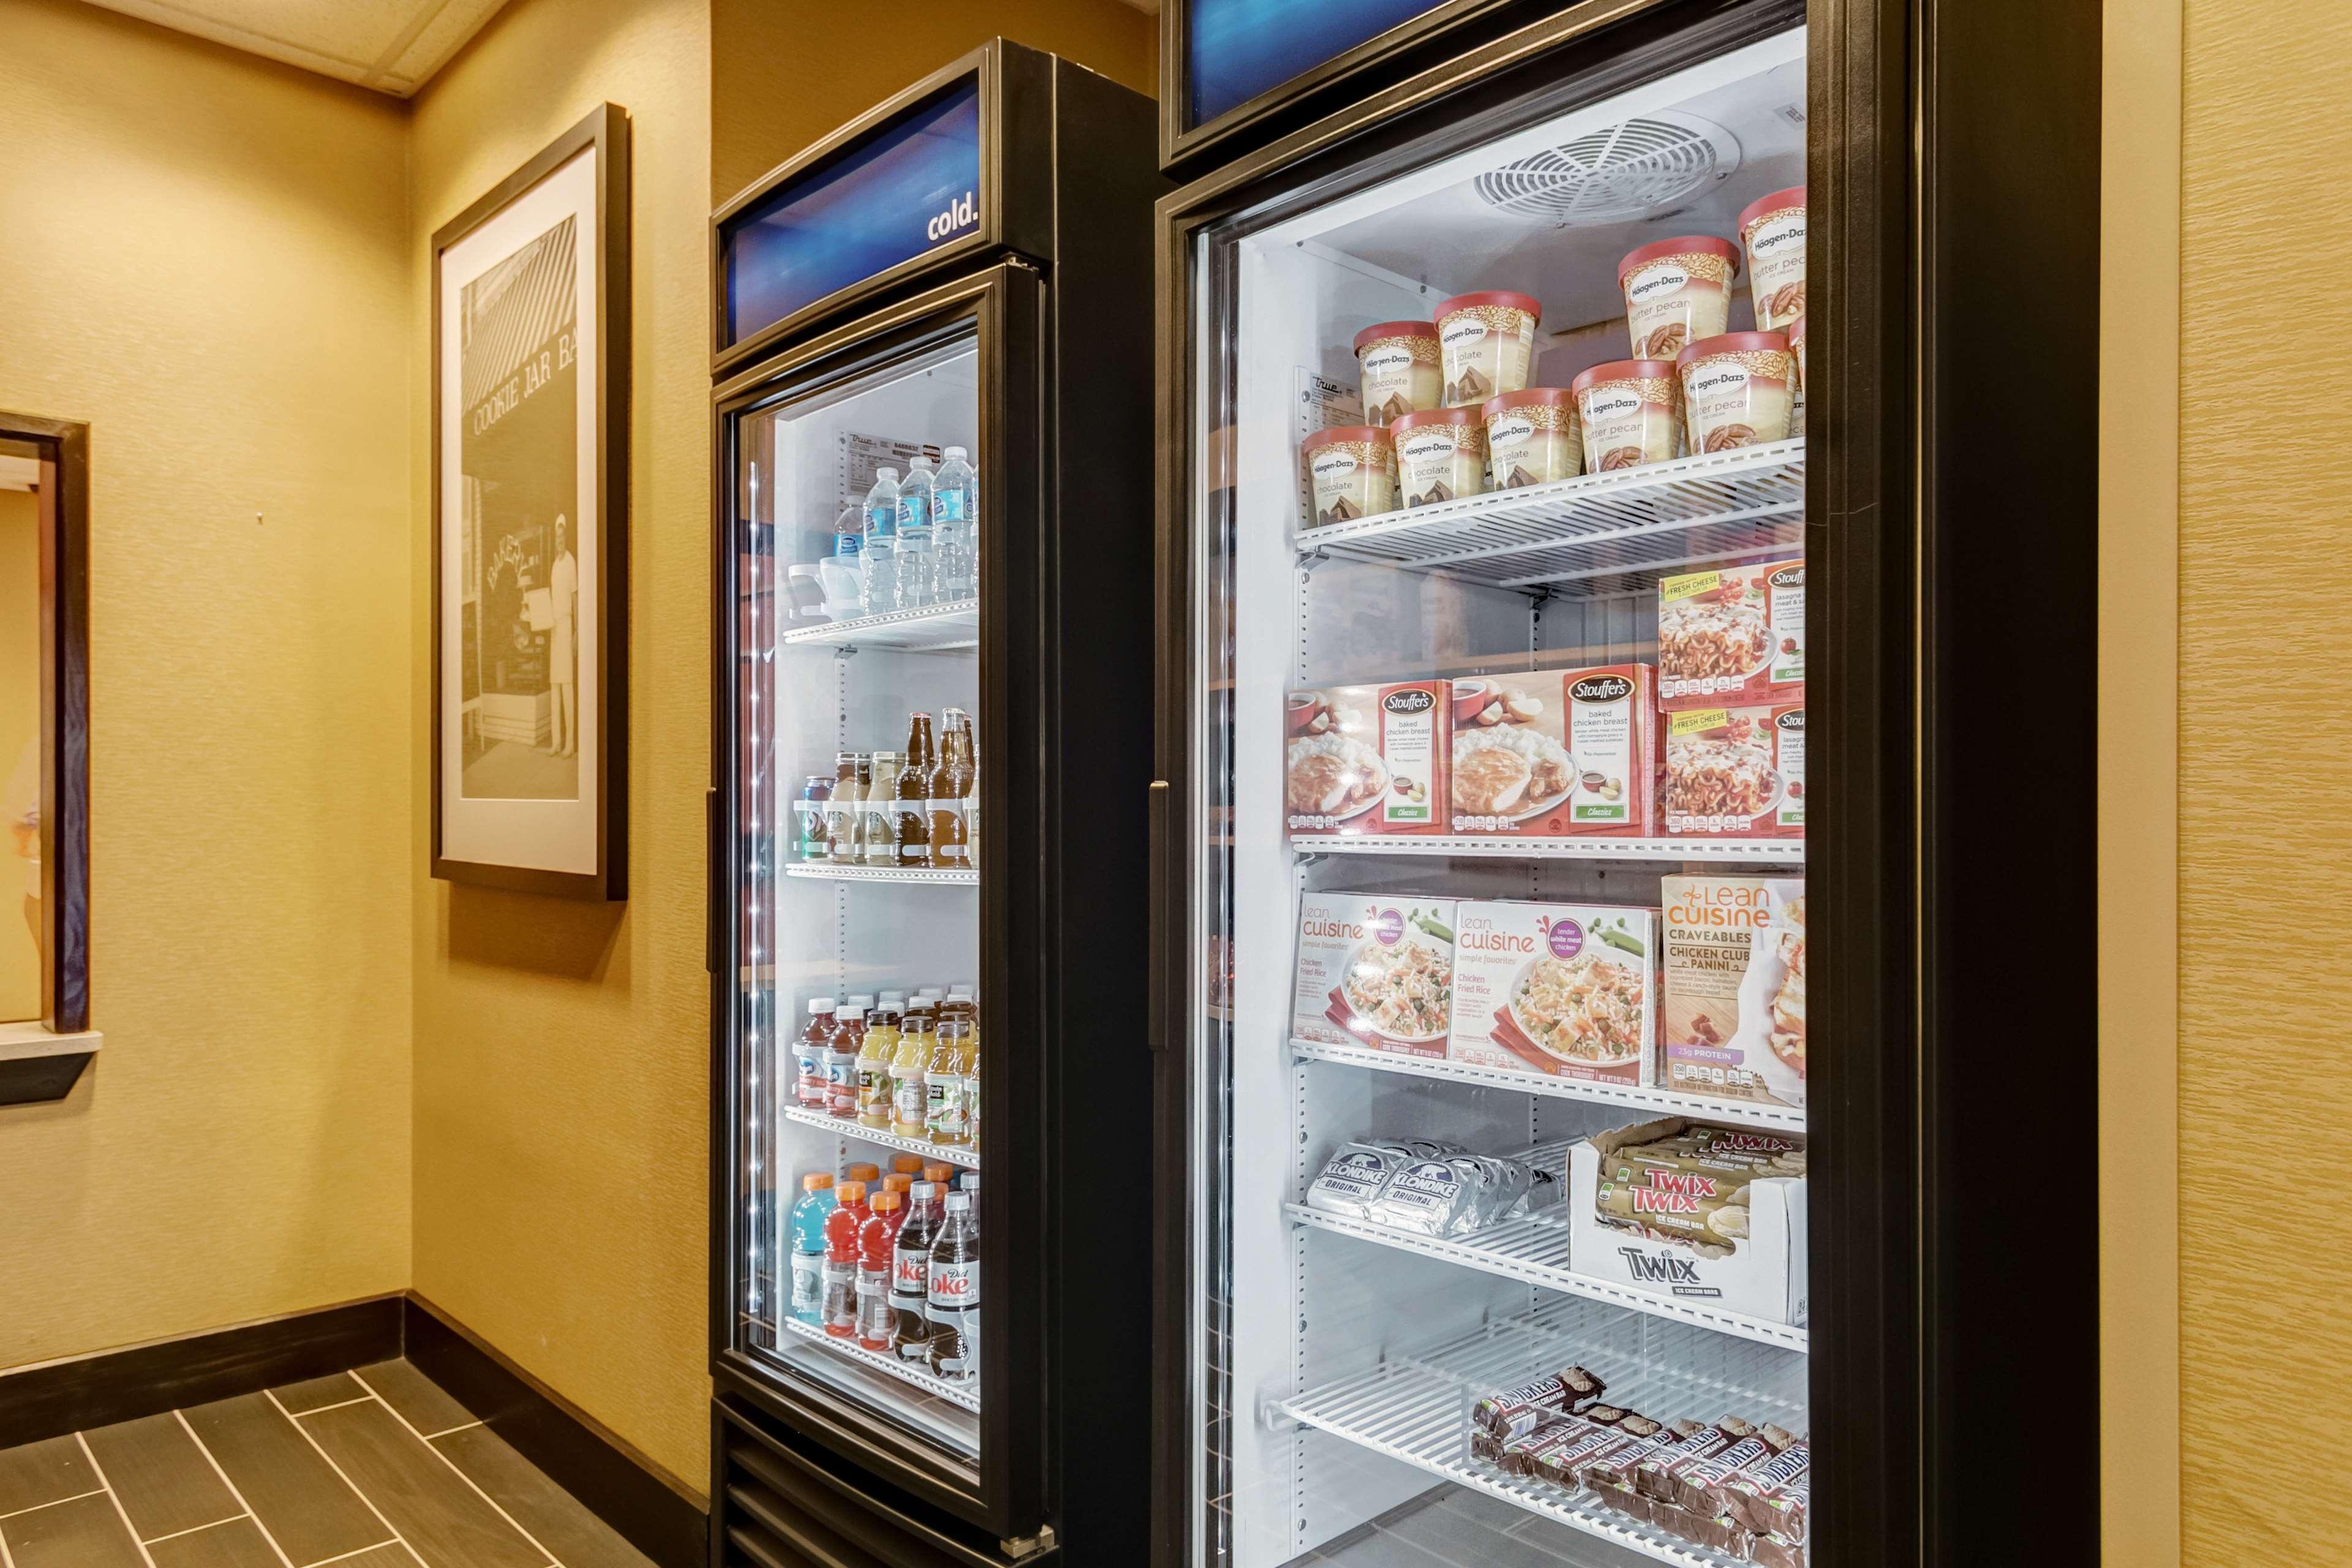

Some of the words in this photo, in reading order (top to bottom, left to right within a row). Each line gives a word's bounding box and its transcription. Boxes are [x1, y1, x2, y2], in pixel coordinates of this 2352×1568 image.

[927, 190, 978, 241] cold.
[1782, 256, 1806, 269] pec
[1632, 275, 1684, 297] Häagen-Dazs
[1656, 299, 1691, 312] pecan
[1368, 377, 1408, 391] chocolate
[473, 376, 519, 436] COOKIE
[524, 351, 551, 399] JAR
[1586, 399, 1638, 415] Hagen-Dazs
[1610, 423, 1644, 435] pecan
[1406, 443, 1452, 456] Häagen-Dazs
[1408, 466, 1450, 479] cocolate
[1670, 584, 1691, 595] FRESH
[1692, 575, 1718, 588] CHEESE
[1575, 679, 1626, 698] Stouffer's
[1388, 692, 1429, 711] Stouffer's
[1588, 709, 1612, 718] baked
[1677, 718, 1698, 729] FRESH
[1700, 712, 1725, 723] CHEESE
[1781, 714, 1804, 727] Stou
[1704, 886, 1770, 907] Lean
[1303, 904, 1330, 919] lean
[1303, 918, 1364, 940] cuisine
[1460, 913, 1493, 930] lean
[1460, 932, 1535, 953] cuisine
[1669, 929, 1752, 944] CRAVEABLES
[1301, 957, 1322, 967] Chicken
[1459, 955, 1482, 963] simple
[1483, 956, 1517, 965] favorites
[1669, 946, 1718, 959] CHICKEN
[1722, 949, 1751, 962] CLUB
[1300, 967, 1314, 976] Fried
[1691, 959, 1730, 971] PANINI
[1458, 973, 1485, 984] Chicken
[1457, 984, 1475, 993] Fried
[1476, 985, 1491, 995] Rice
[1678, 1047, 1692, 1057] 23g
[1694, 1049, 1732, 1060] PROTEIN
[1711, 1160, 1734, 1169] CREAM
[1324, 1162, 1387, 1185] KLONDIKE
[1324, 1179, 1362, 1194] ORIGINAL
[1390, 1173, 1459, 1197] KLONDIKE
[1393, 1190, 1432, 1206] ORIGINAL
[1656, 1214, 1666, 1223] ICE
[1666, 1215, 1691, 1227] CREAM
[1691, 1221, 1705, 1231] BAR
[895, 1259, 929, 1281] oke
[931, 1273, 969, 1295] oke
[1494, 1377, 1561, 1409] SNICKERS
[1522, 1419, 1579, 1447] SNICKER
[1564, 1431, 1618, 1459] SNICKER
